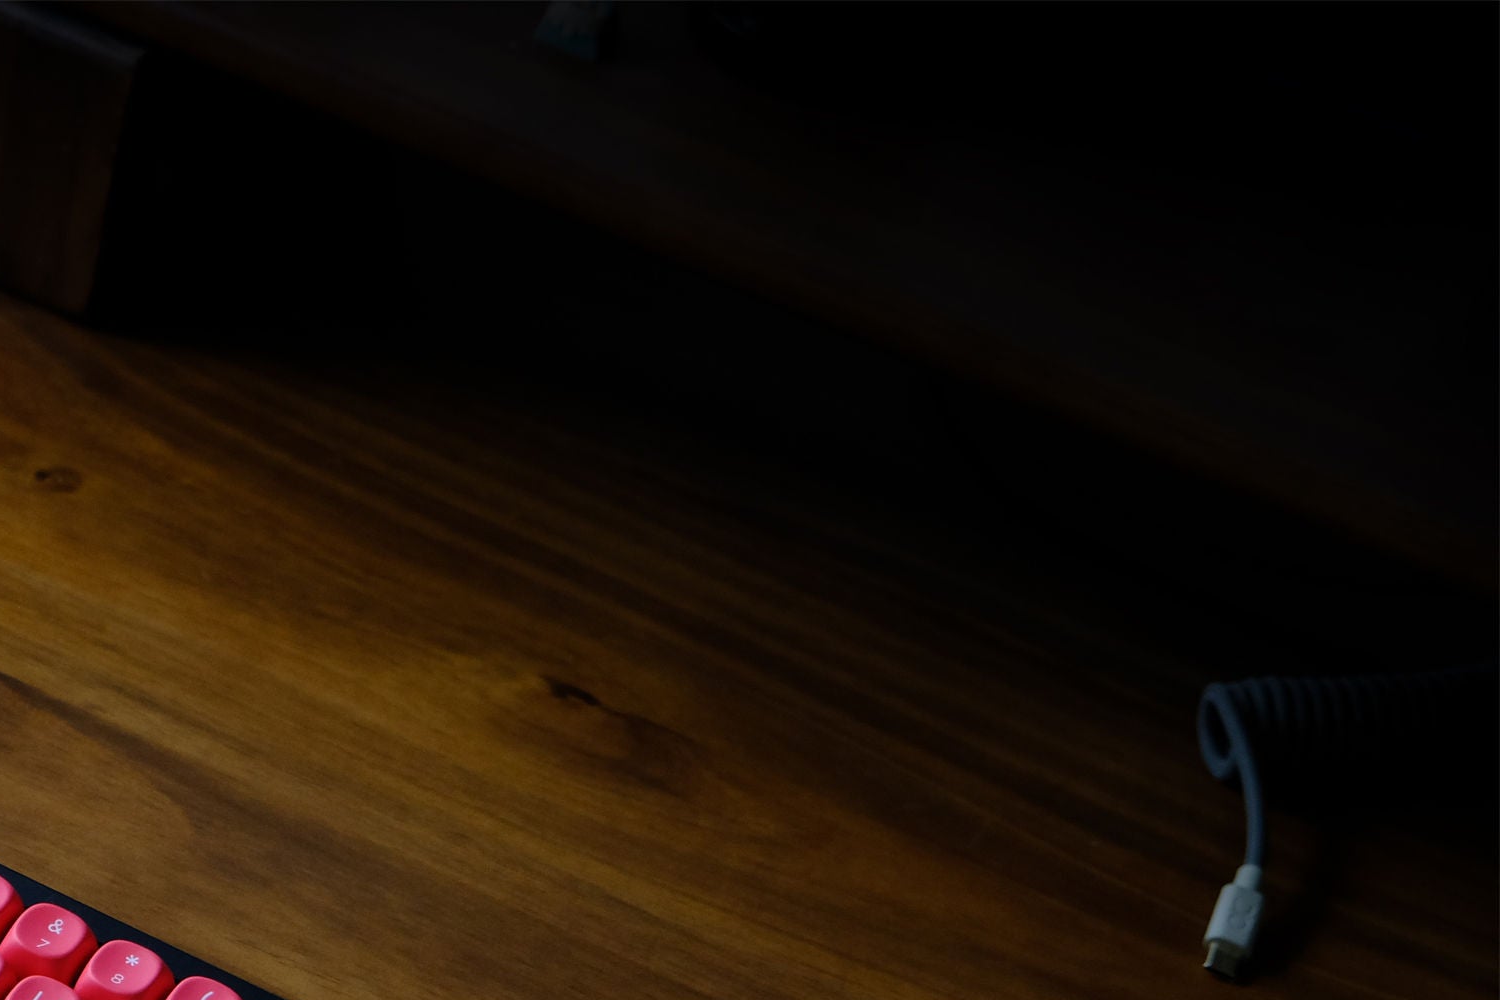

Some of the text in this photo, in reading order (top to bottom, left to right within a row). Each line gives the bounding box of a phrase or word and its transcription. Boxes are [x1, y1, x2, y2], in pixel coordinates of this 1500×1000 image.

[47, 918, 64, 935] &
[35, 938, 51, 948] 7
[110, 973, 125, 984] 8
